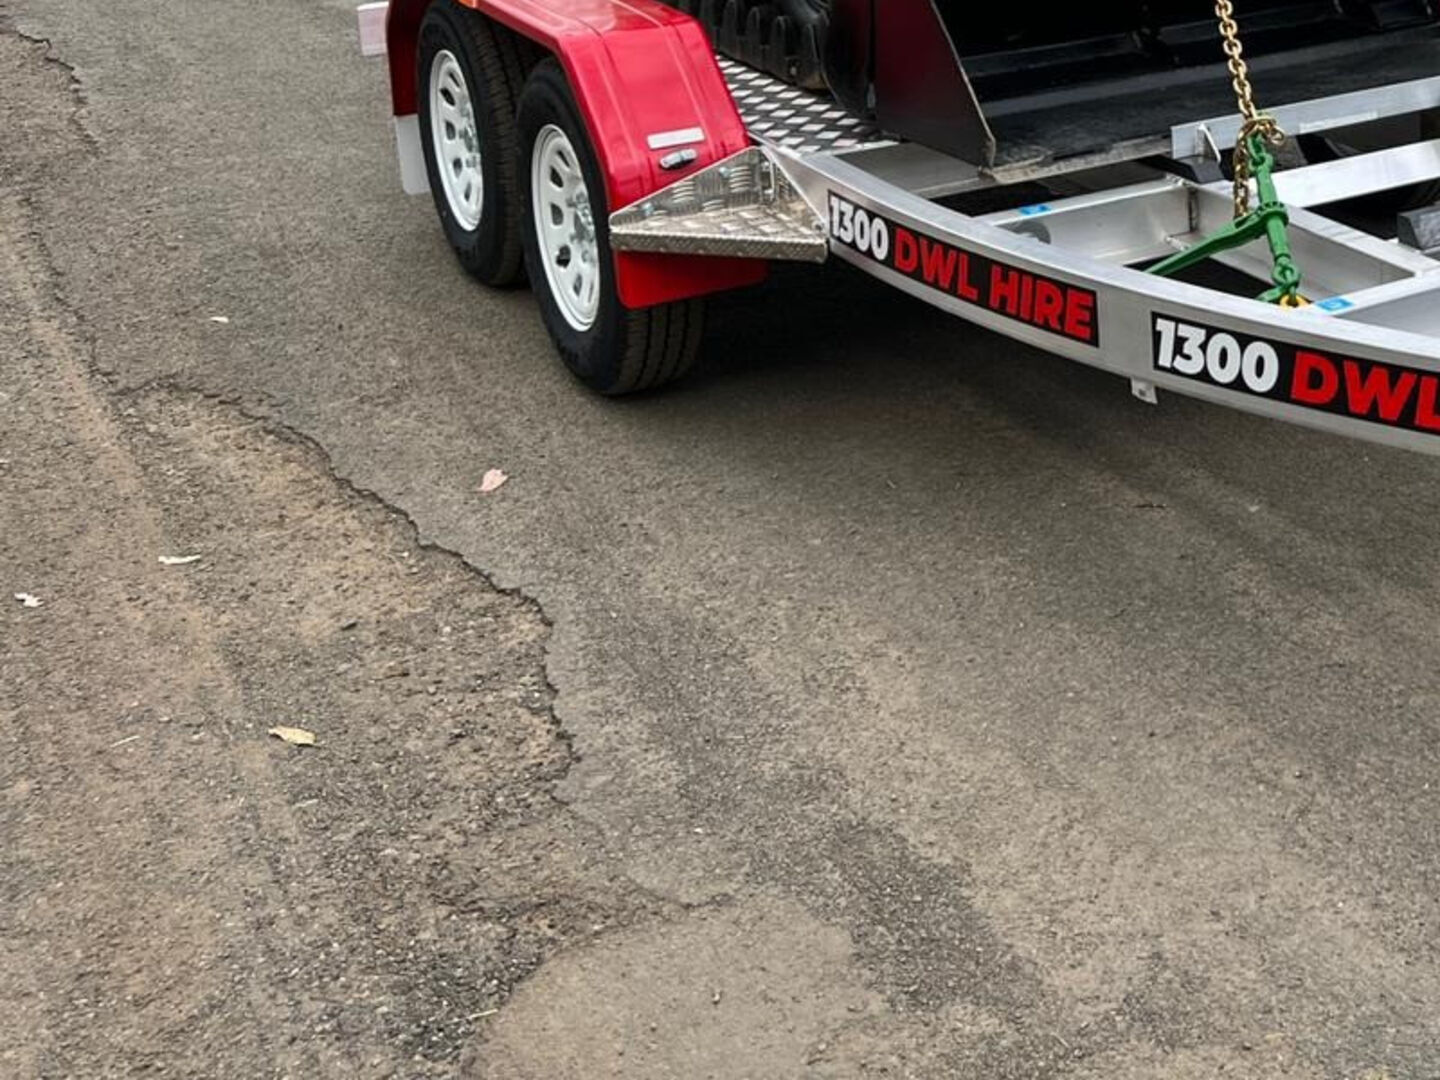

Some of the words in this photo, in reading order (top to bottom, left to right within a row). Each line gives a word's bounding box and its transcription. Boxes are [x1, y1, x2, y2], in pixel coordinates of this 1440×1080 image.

[830, 196, 889, 261] 1300
[894, 227, 978, 301] DWL
[989, 265, 1094, 340] HIRE
[1155, 318, 1279, 393] 1300
